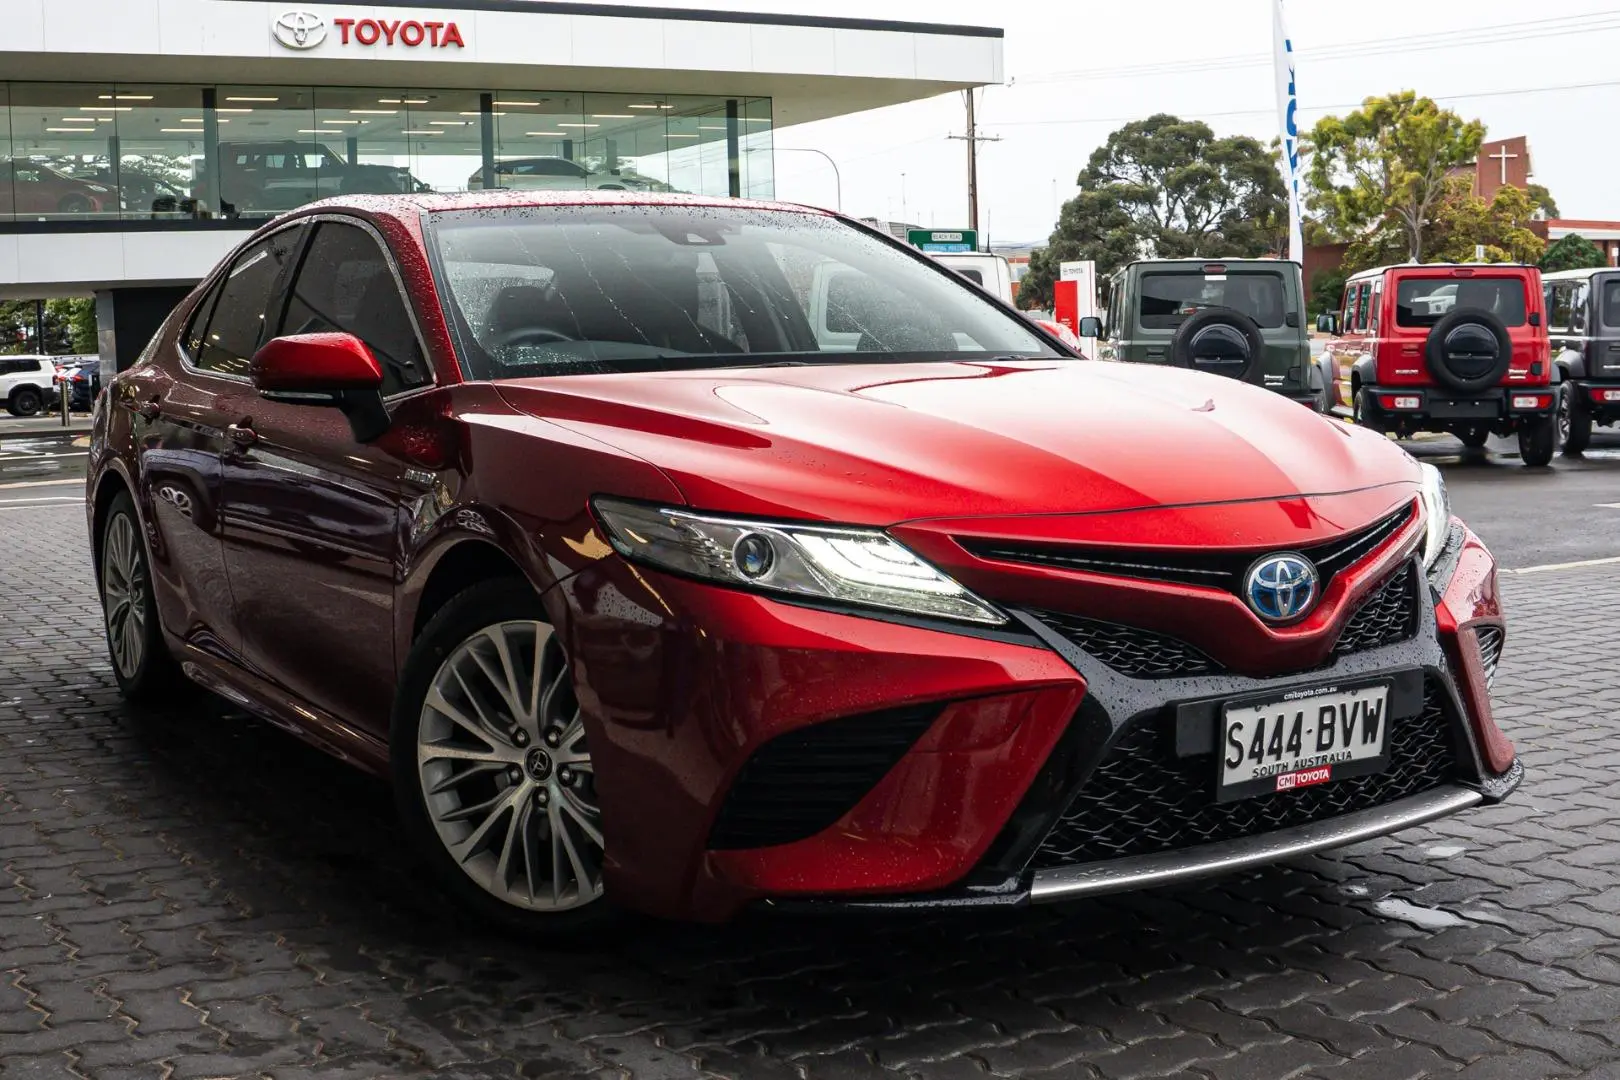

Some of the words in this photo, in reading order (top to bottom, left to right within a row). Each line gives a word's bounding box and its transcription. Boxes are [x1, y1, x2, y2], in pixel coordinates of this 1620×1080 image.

[334, 18, 465, 48] TOYOTA
[1284, 686, 1338, 700] cmitoyota.com.au
[1252, 762, 1289, 778] SOUTH
[1294, 750, 1353, 771] AUSTRALIA
[1296, 769, 1330, 785] TOYOTA
